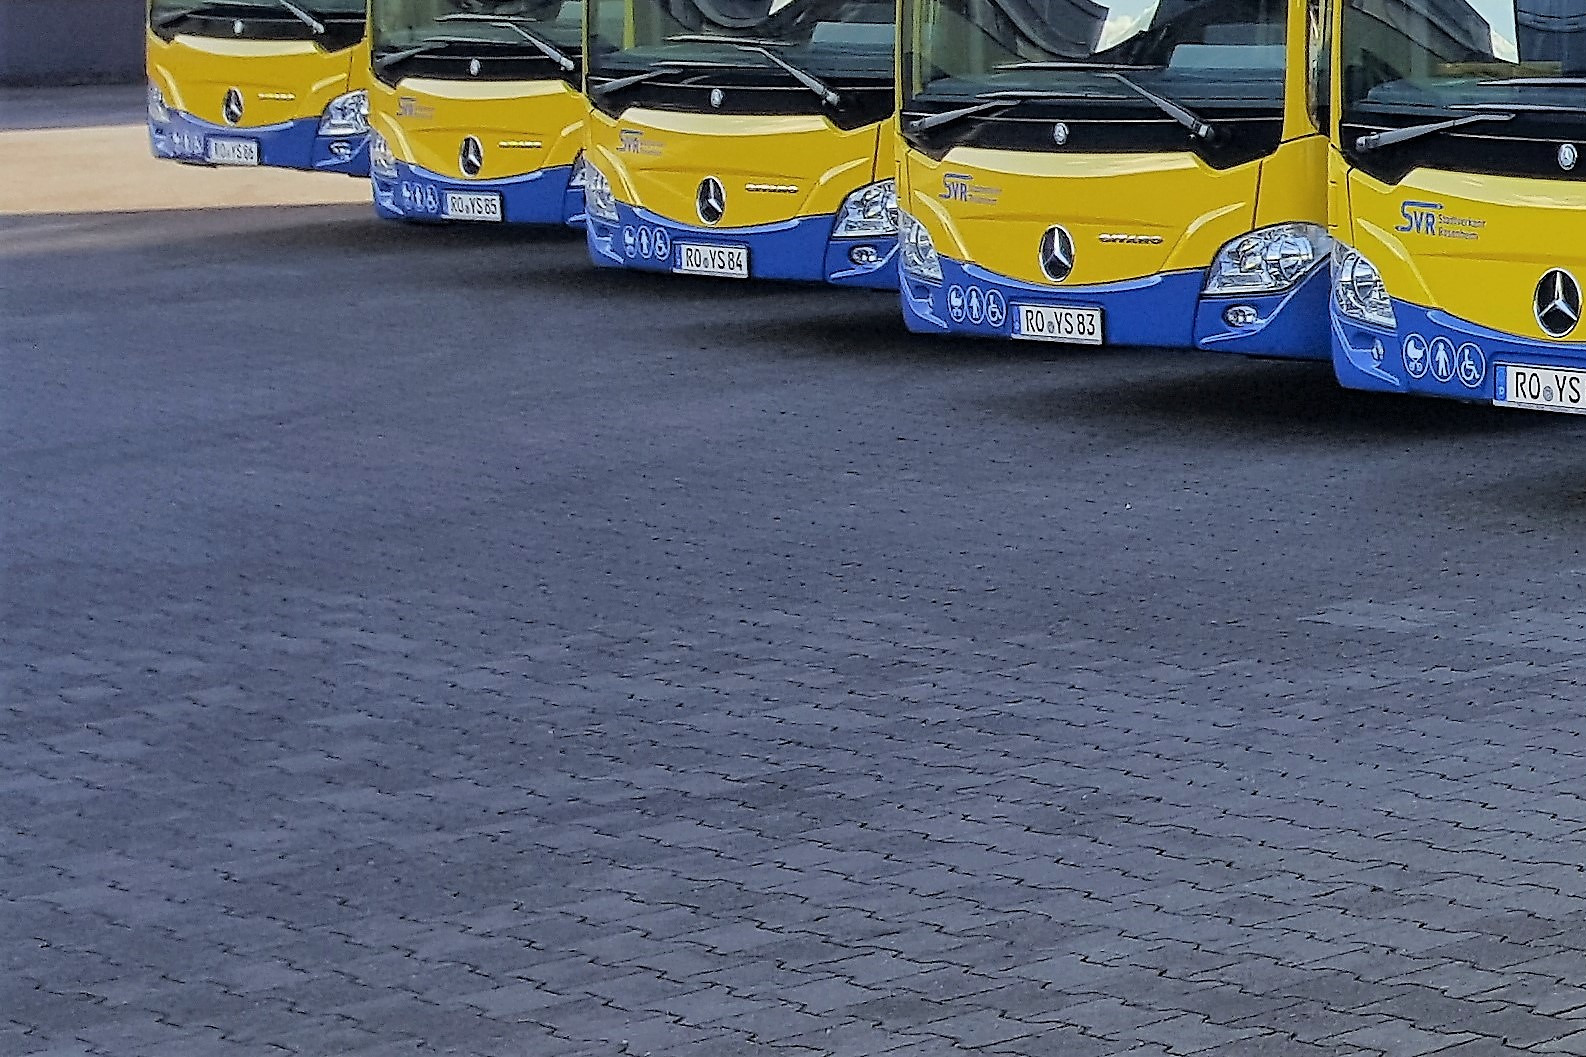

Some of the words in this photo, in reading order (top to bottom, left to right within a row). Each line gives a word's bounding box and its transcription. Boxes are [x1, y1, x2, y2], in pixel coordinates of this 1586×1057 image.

[1395, 200, 1443, 236] SVR
[686, 248, 702, 268] RO
[709, 249, 726, 270] YS
[728, 251, 743, 271] 84
[1026, 309, 1045, 333] RO
[1054, 311, 1074, 335] YS
[1077, 313, 1096, 336] 83
[1515, 371, 1540, 400] RO
[1555, 374, 1581, 404] YS
